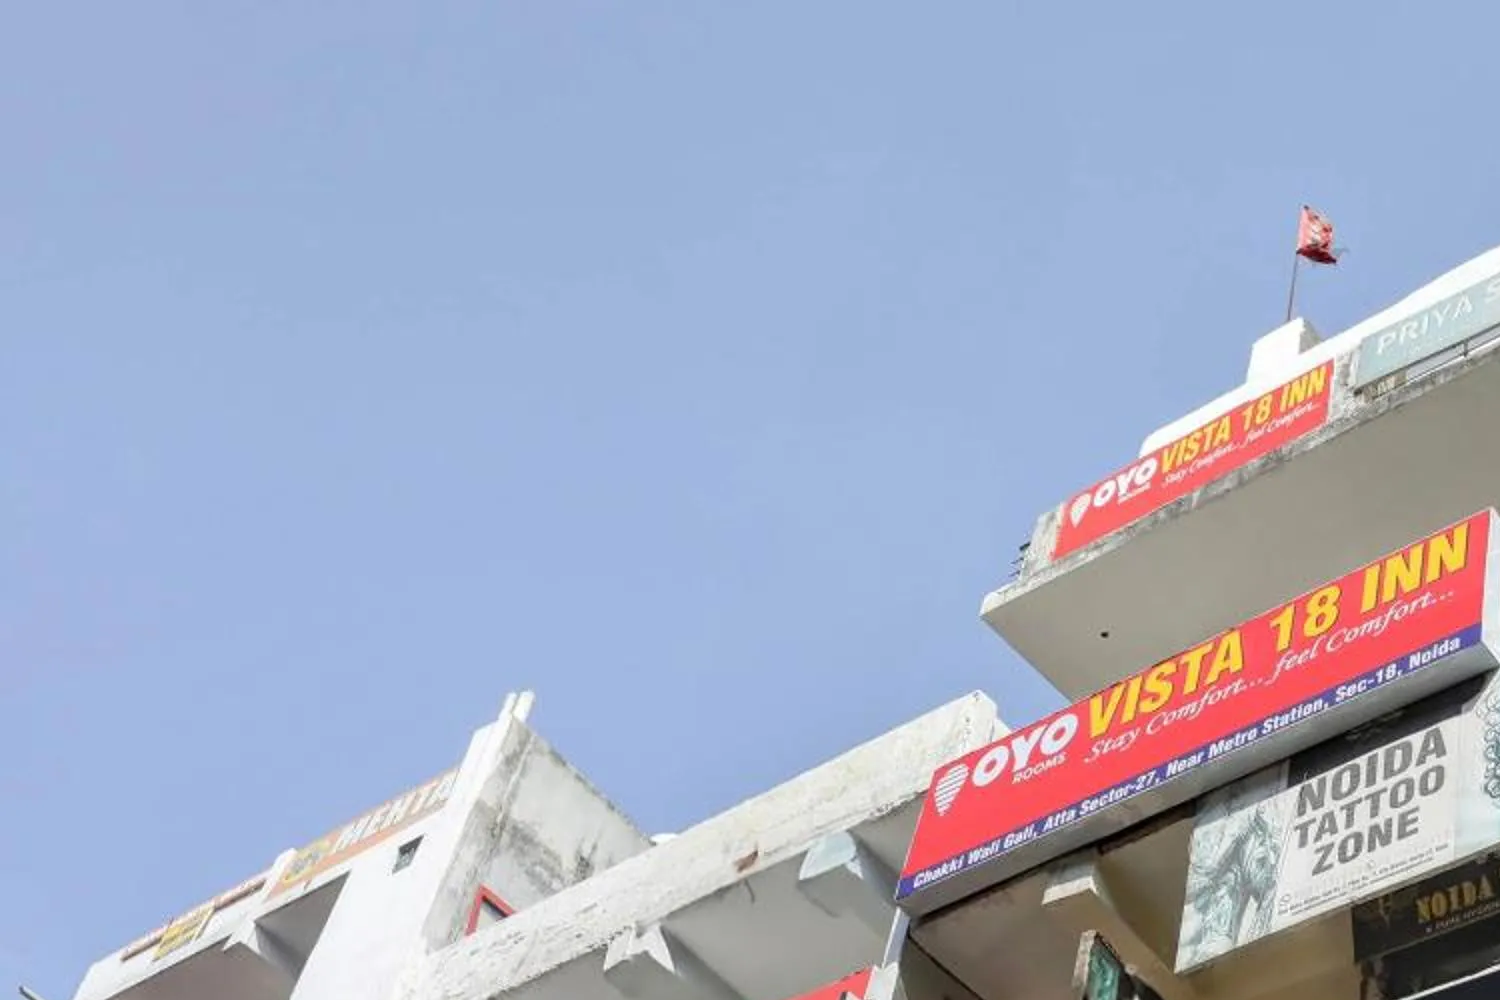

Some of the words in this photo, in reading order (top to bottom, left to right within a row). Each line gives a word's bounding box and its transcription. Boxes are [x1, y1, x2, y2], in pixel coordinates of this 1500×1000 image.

[1377, 296, 1473, 356] PRIYA
[1093, 457, 1158, 507] OYO
[1161, 416, 1231, 473] VISTA
[1242, 394, 1272, 431] 18
[1279, 366, 1327, 412] INN
[972, 713, 1078, 787] OYO
[1089, 629, 1246, 739] VISTA
[1270, 585, 1342, 652] 18
[1360, 522, 1471, 613] INN
[1084, 725, 1141, 763] Stay
[1267, 641, 1319, 685] feel
[913, 858, 963, 888] Chakki
[967, 843, 1000, 868] Wali
[1003, 827, 1038, 849] Gali,
[1042, 810, 1076, 833] Atta
[1079, 770, 1161, 813] Sector-27,
[1166, 752, 1204, 778] Near
[1208, 729, 1257, 761] Metro
[1262, 700, 1329, 734] Station,
[1335, 663, 1404, 703] Sec-18,
[1409, 636, 1461, 667] Noida
[1012, 751, 1066, 784] ROOMS
[1297, 727, 1447, 817] NOIDA
[1295, 764, 1445, 848] TATTOO
[1312, 806, 1420, 876] ZONE
[1415, 875, 1495, 923] NOIDA
